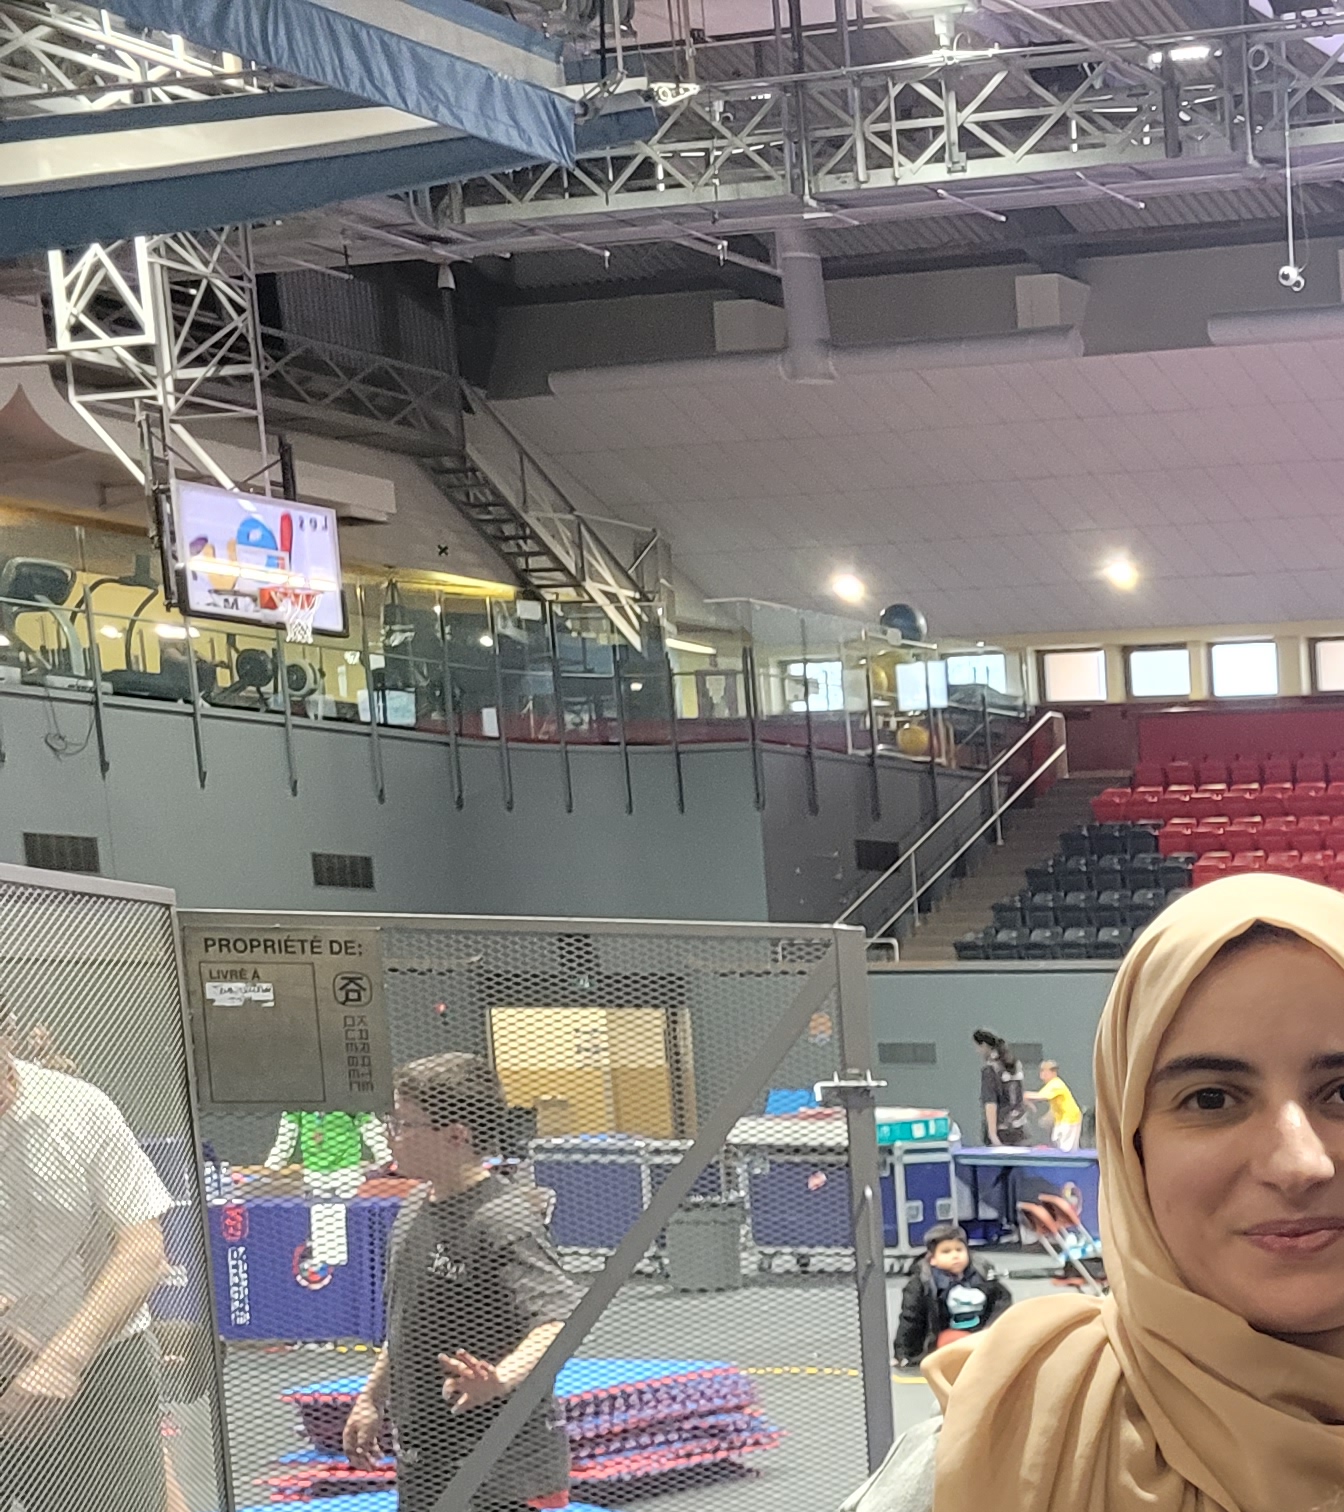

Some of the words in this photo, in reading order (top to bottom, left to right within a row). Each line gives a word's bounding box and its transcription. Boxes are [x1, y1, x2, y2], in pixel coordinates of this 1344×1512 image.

[203, 936, 323, 955] PROPRIÉTÉ
[329, 939, 363, 957] DE:
[208, 968, 247, 980] LIVRÉ
